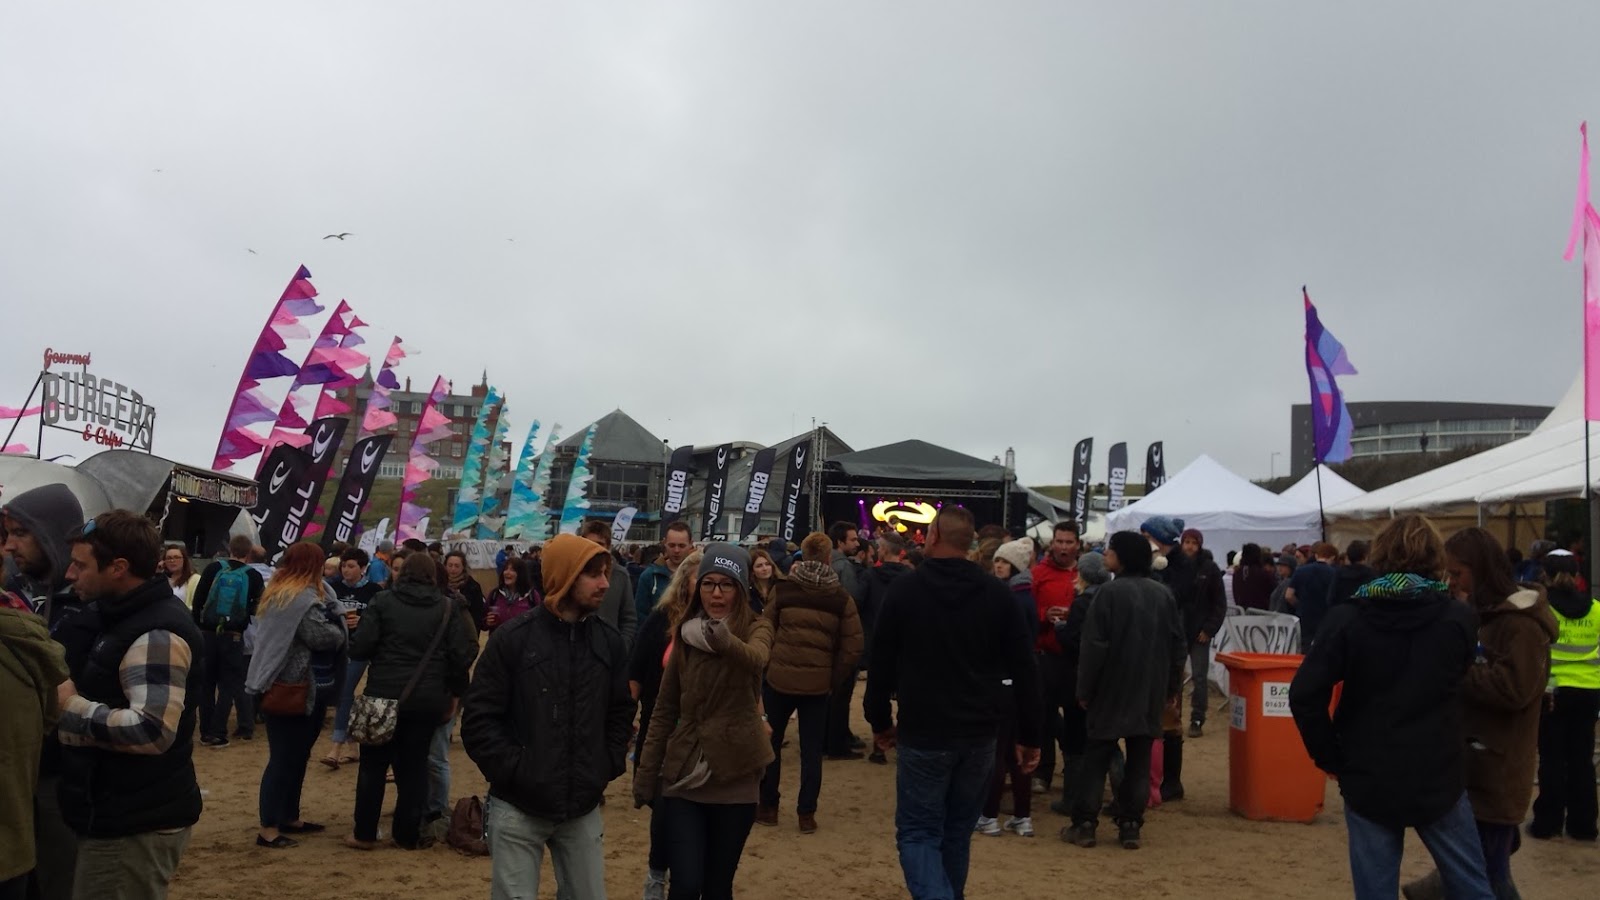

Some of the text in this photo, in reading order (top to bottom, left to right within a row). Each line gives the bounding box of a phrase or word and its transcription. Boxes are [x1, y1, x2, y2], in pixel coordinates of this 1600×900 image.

[42, 371, 156, 450] BURGERS
[95, 426, 123, 448] Chips
[664, 469, 687, 514] Butta
[745, 471, 769, 514] Butta
[785, 478, 801, 541] O'NEILL
